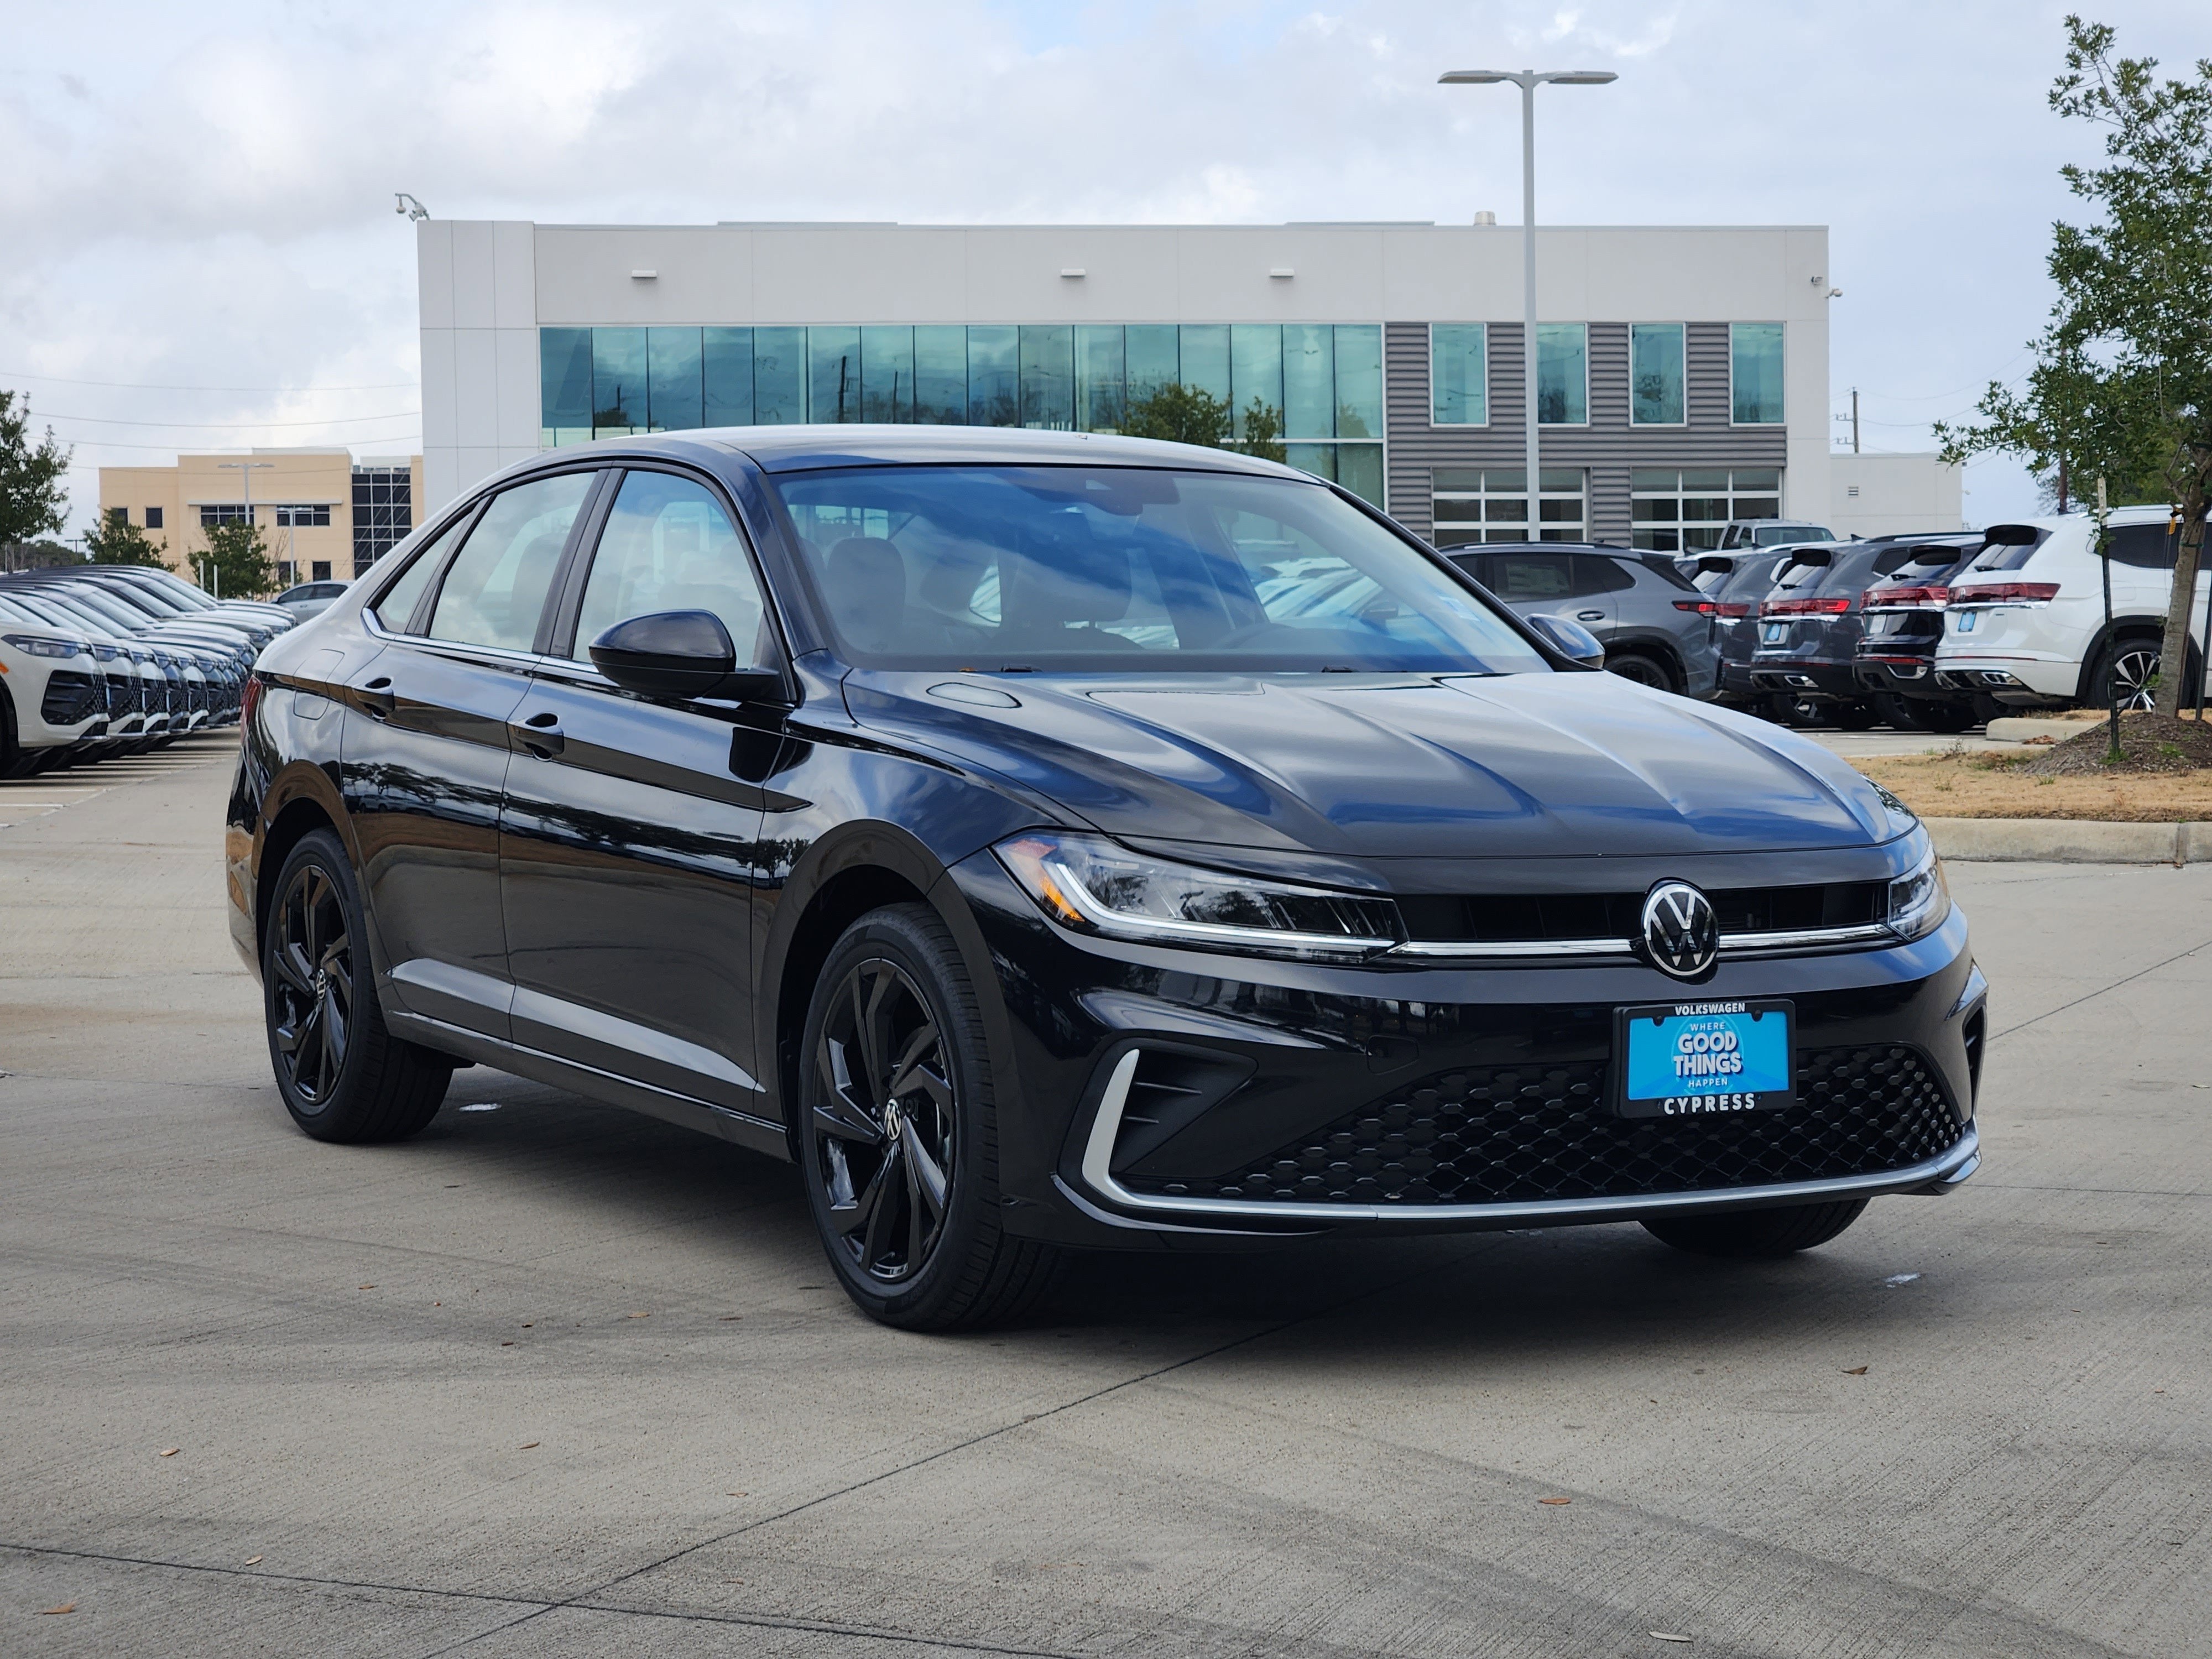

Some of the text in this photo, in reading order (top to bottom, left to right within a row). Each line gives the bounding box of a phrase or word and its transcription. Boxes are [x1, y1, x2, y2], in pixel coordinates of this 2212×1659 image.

[1675, 1003, 1745, 1015] VOLKSWAGEN
[1690, 1022, 1725, 1031] WHERE
[1678, 1031, 1738, 1053] GOOD
[1673, 1051, 1742, 1076] THINGS
[1688, 1078, 1728, 1088] HAPPEN
[1664, 1093, 1755, 1115] CYPRESS
